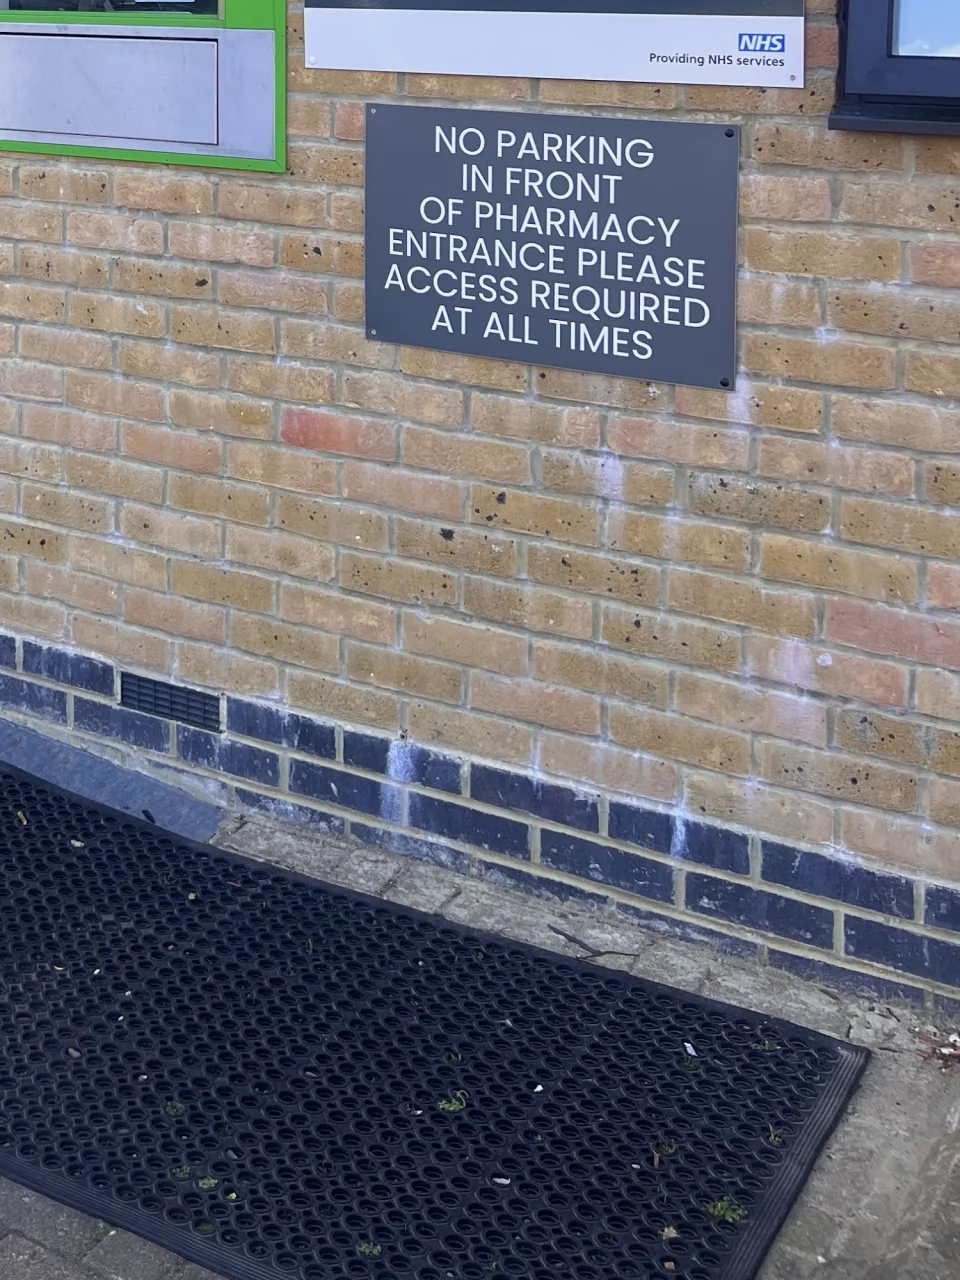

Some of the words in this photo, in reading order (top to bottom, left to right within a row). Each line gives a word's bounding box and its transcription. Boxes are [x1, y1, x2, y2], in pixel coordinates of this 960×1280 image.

[649, 52, 705, 66] Providing
[708, 54, 733, 65] NHS
[736, 55, 785, 67] services
[739, 34, 784, 51] NHS
[434, 125, 485, 156] NO
[497, 129, 655, 169] PARKING
[461, 163, 493, 193] IN
[506, 167, 623, 204] FRONT
[420, 196, 464, 226] OF
[475, 201, 680, 247] PHARMACY
[388, 228, 565, 275] ENTRANCE
[578, 248, 705, 290] PLEASE
[384, 263, 519, 306] ACCESS
[531, 281, 711, 328] REQUIRED
[431, 304, 473, 335] AT
[483, 311, 538, 346] ALL
[549, 319, 654, 361] TIMES
